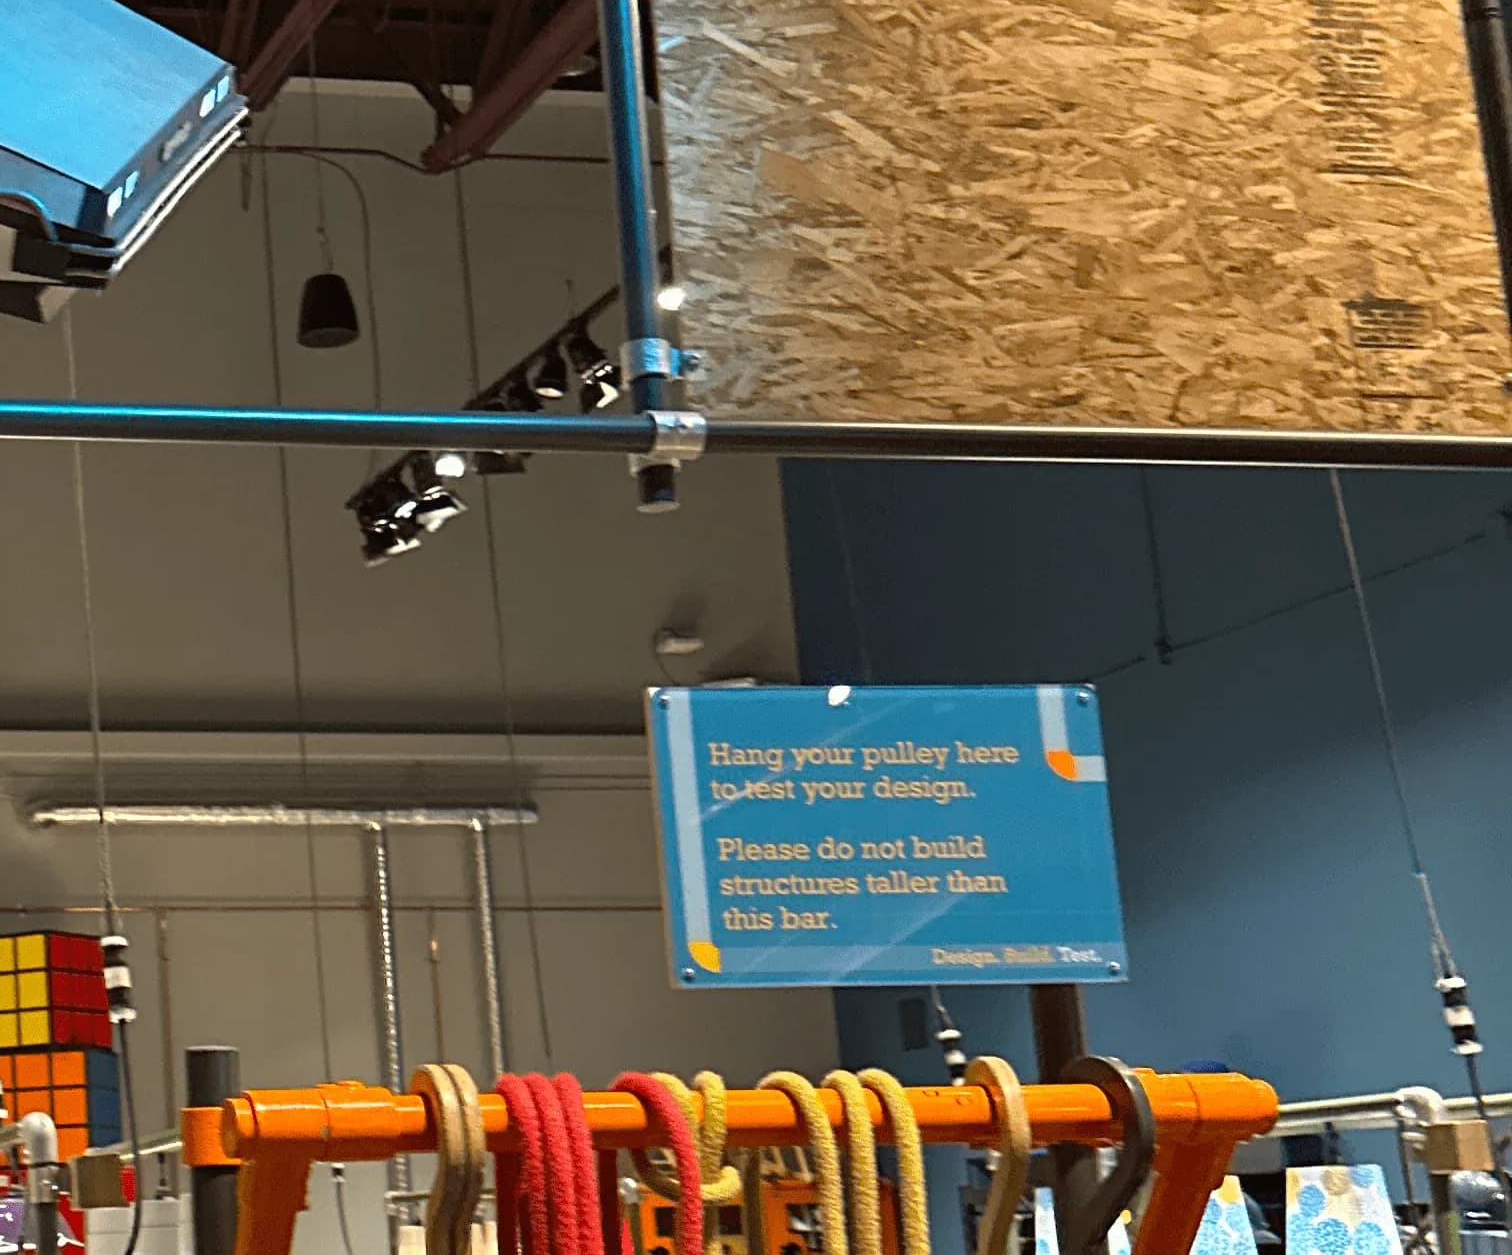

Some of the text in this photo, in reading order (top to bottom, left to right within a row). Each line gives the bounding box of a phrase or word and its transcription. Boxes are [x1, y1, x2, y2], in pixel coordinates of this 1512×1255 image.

[707, 740, 1020, 772] Hang your pulley here
[709, 775, 977, 805] to test your design.
[716, 835, 988, 861] Please do not build
[719, 869, 1008, 895] structures taller than
[722, 905, 838, 930] this bar.
[931, 947, 1001, 968] Design.
